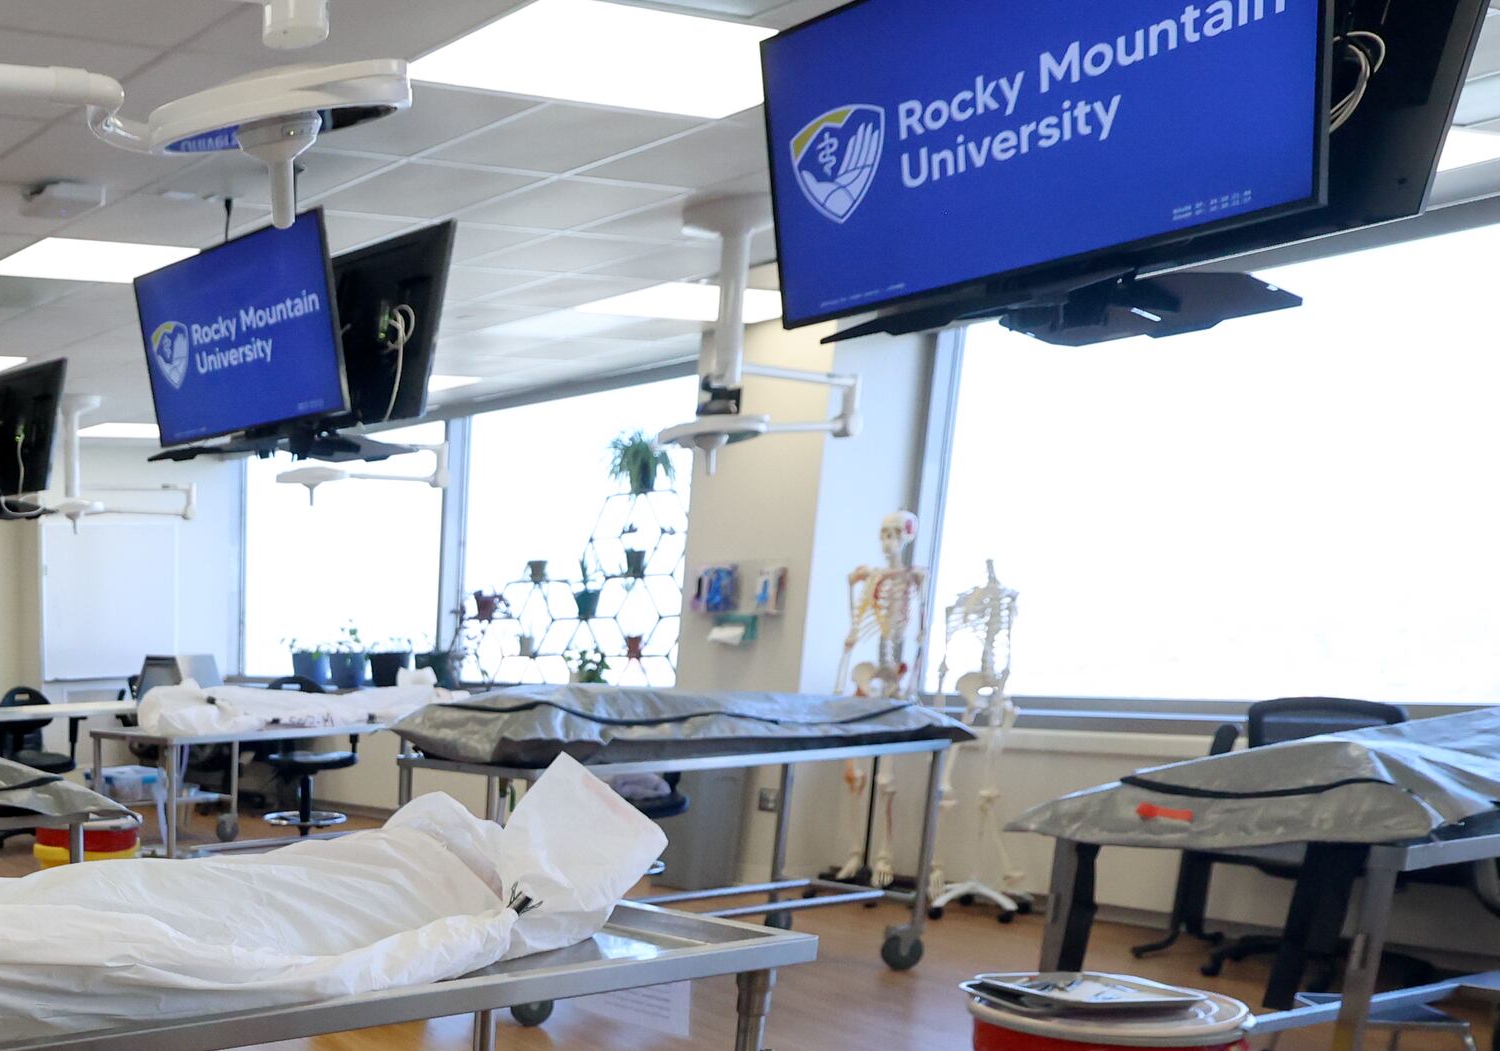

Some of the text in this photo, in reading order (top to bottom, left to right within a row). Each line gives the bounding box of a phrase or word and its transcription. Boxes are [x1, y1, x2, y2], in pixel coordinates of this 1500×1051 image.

[899, 71, 1024, 140] Rocky
[901, 94, 1122, 188] University
[191, 290, 320, 346] Rocky Mountain
[195, 338, 272, 374] University
